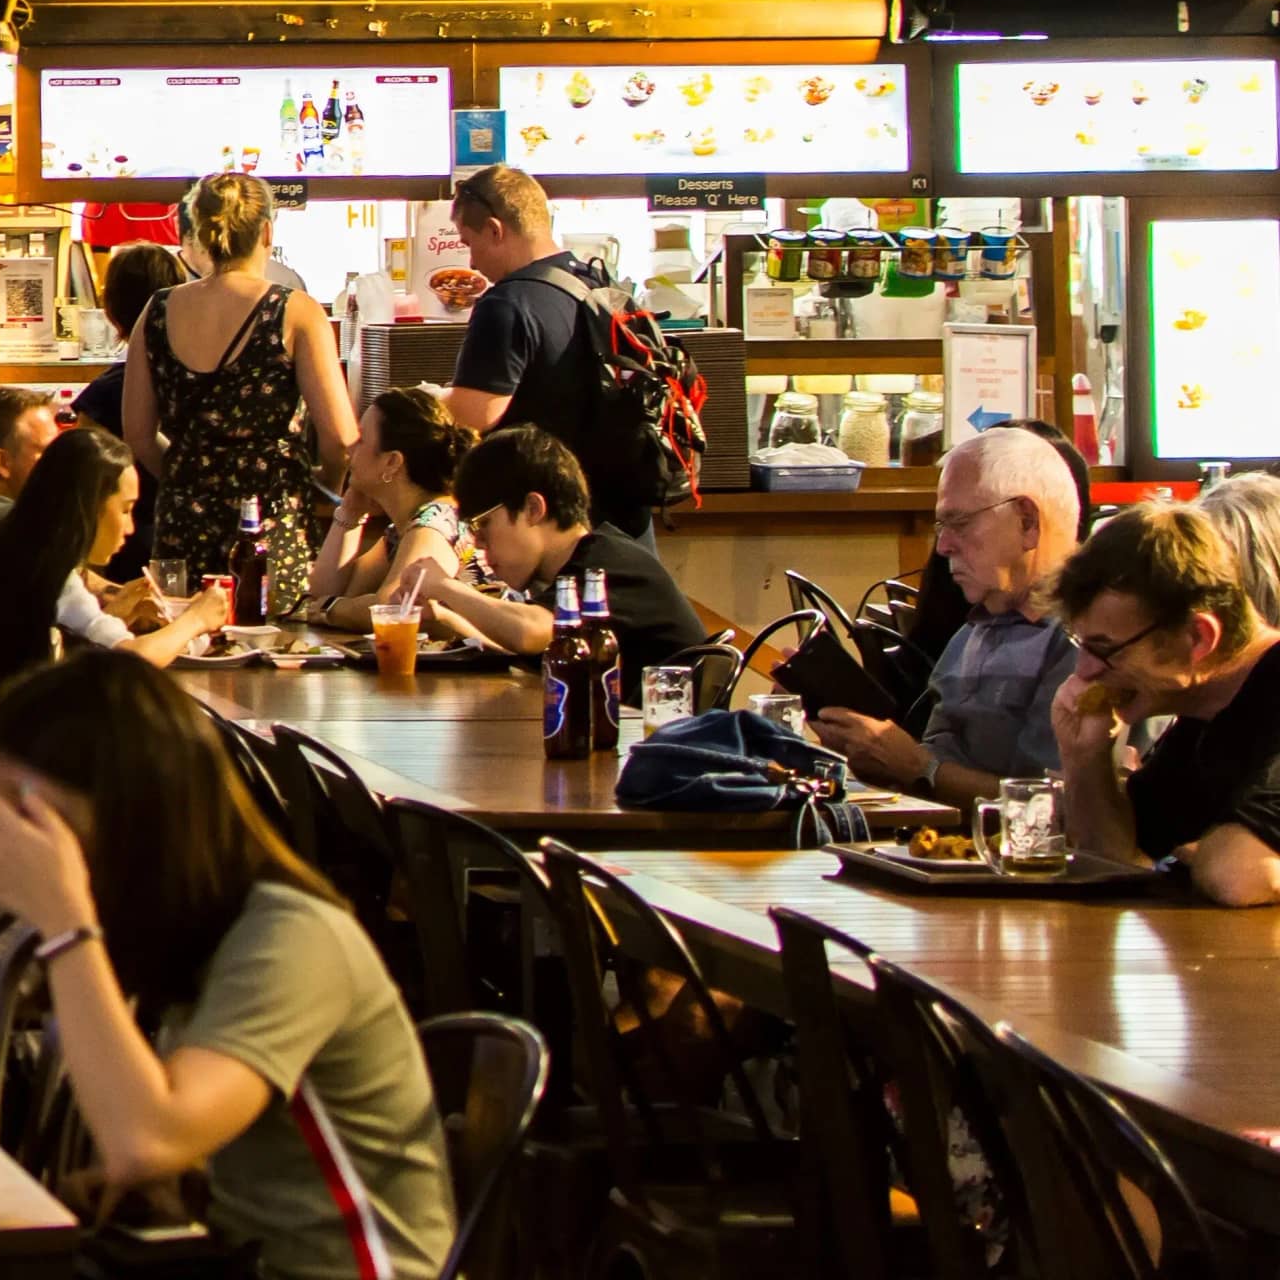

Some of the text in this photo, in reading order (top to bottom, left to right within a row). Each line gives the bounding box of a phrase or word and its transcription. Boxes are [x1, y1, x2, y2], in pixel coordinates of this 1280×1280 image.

[271, 184, 303, 195] erage
[678, 178, 734, 191] Desserts
[912, 178, 928, 189] K1
[653, 194, 697, 206] Please
[727, 193, 759, 205] Here
[427, 237, 469, 256] Spec
